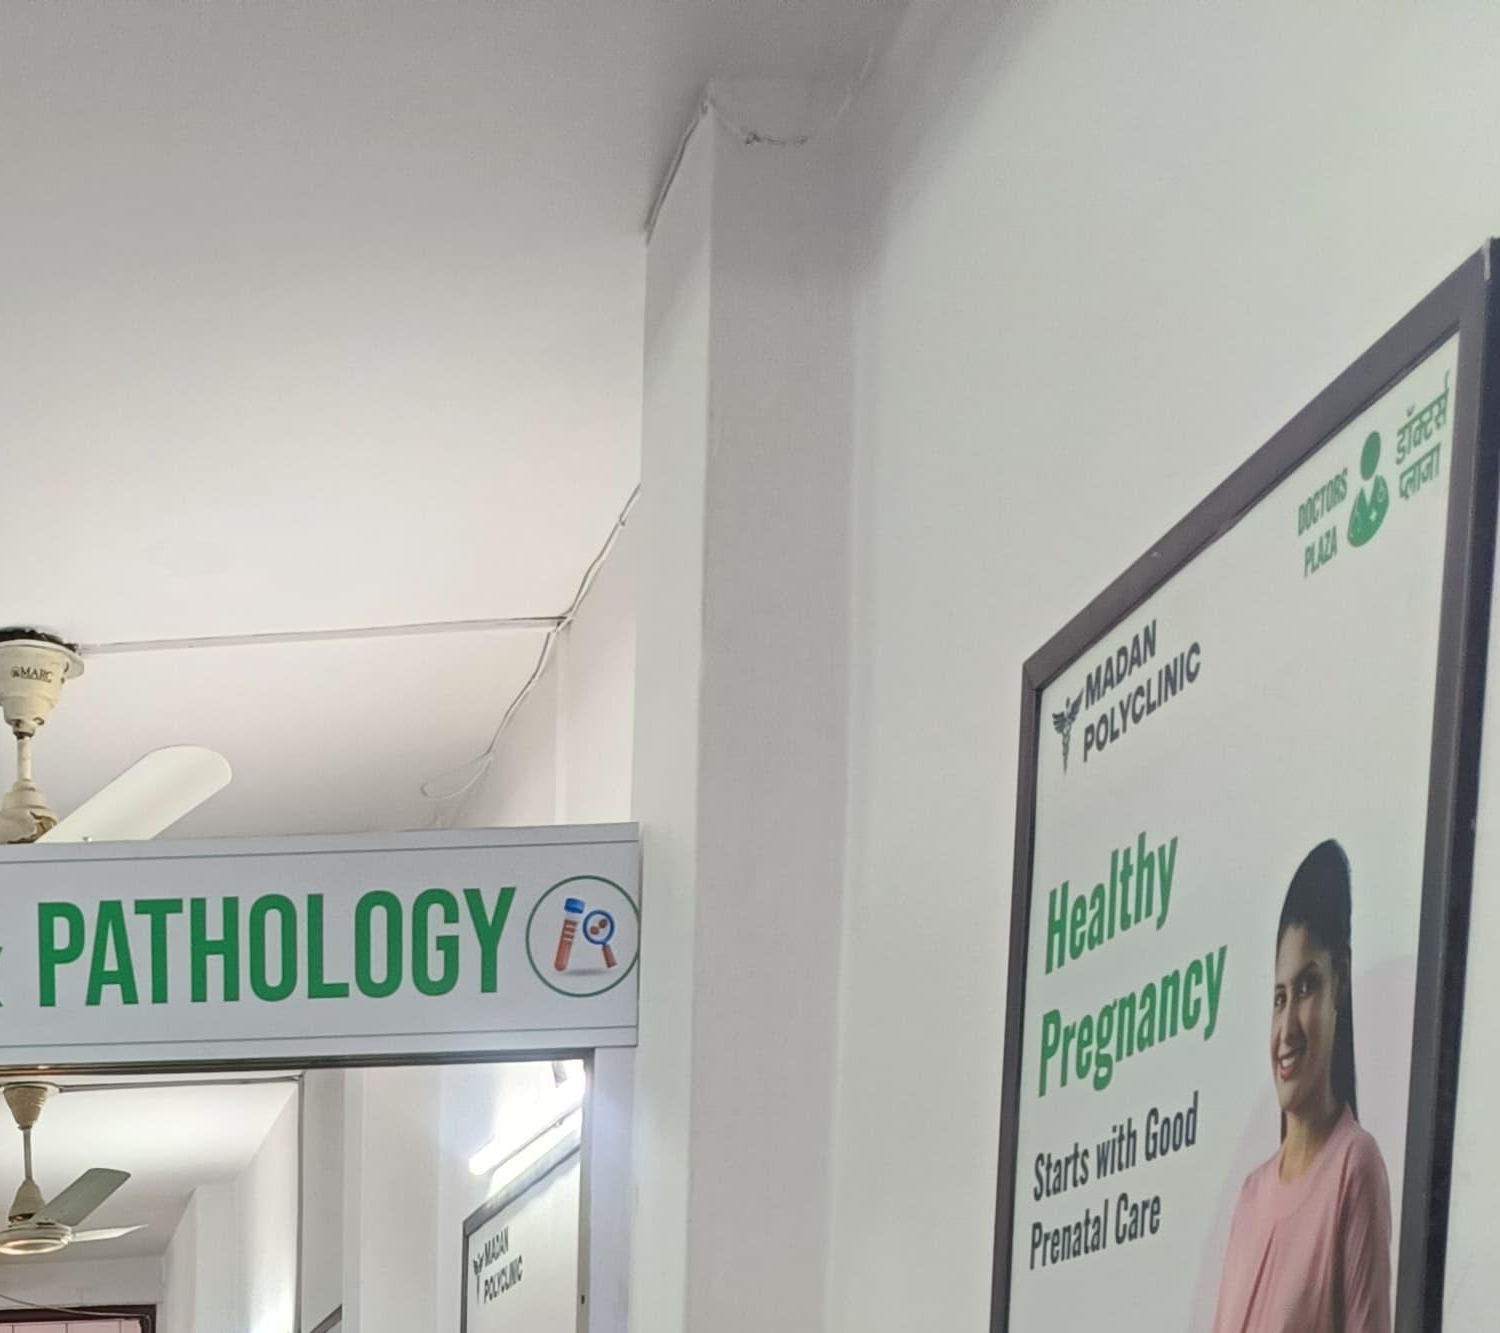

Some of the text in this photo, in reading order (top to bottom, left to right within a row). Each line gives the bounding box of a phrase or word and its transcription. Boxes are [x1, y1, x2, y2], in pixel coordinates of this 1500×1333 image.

[1297, 467, 1348, 536] DOCTORS
[1303, 526, 1338, 579] PLAZA
[1082, 641, 1201, 763] POLYCLINIC
[1083, 619, 1157, 708] MADAN
[37, 887, 516, 1007] PATHOLOGY
[1044, 830, 1178, 975] Healthy
[1037, 943, 1228, 1099] Pregnancy
[1032, 1090, 1198, 1203] Starts with Good
[1029, 1193, 1161, 1271] Prenatal Care
